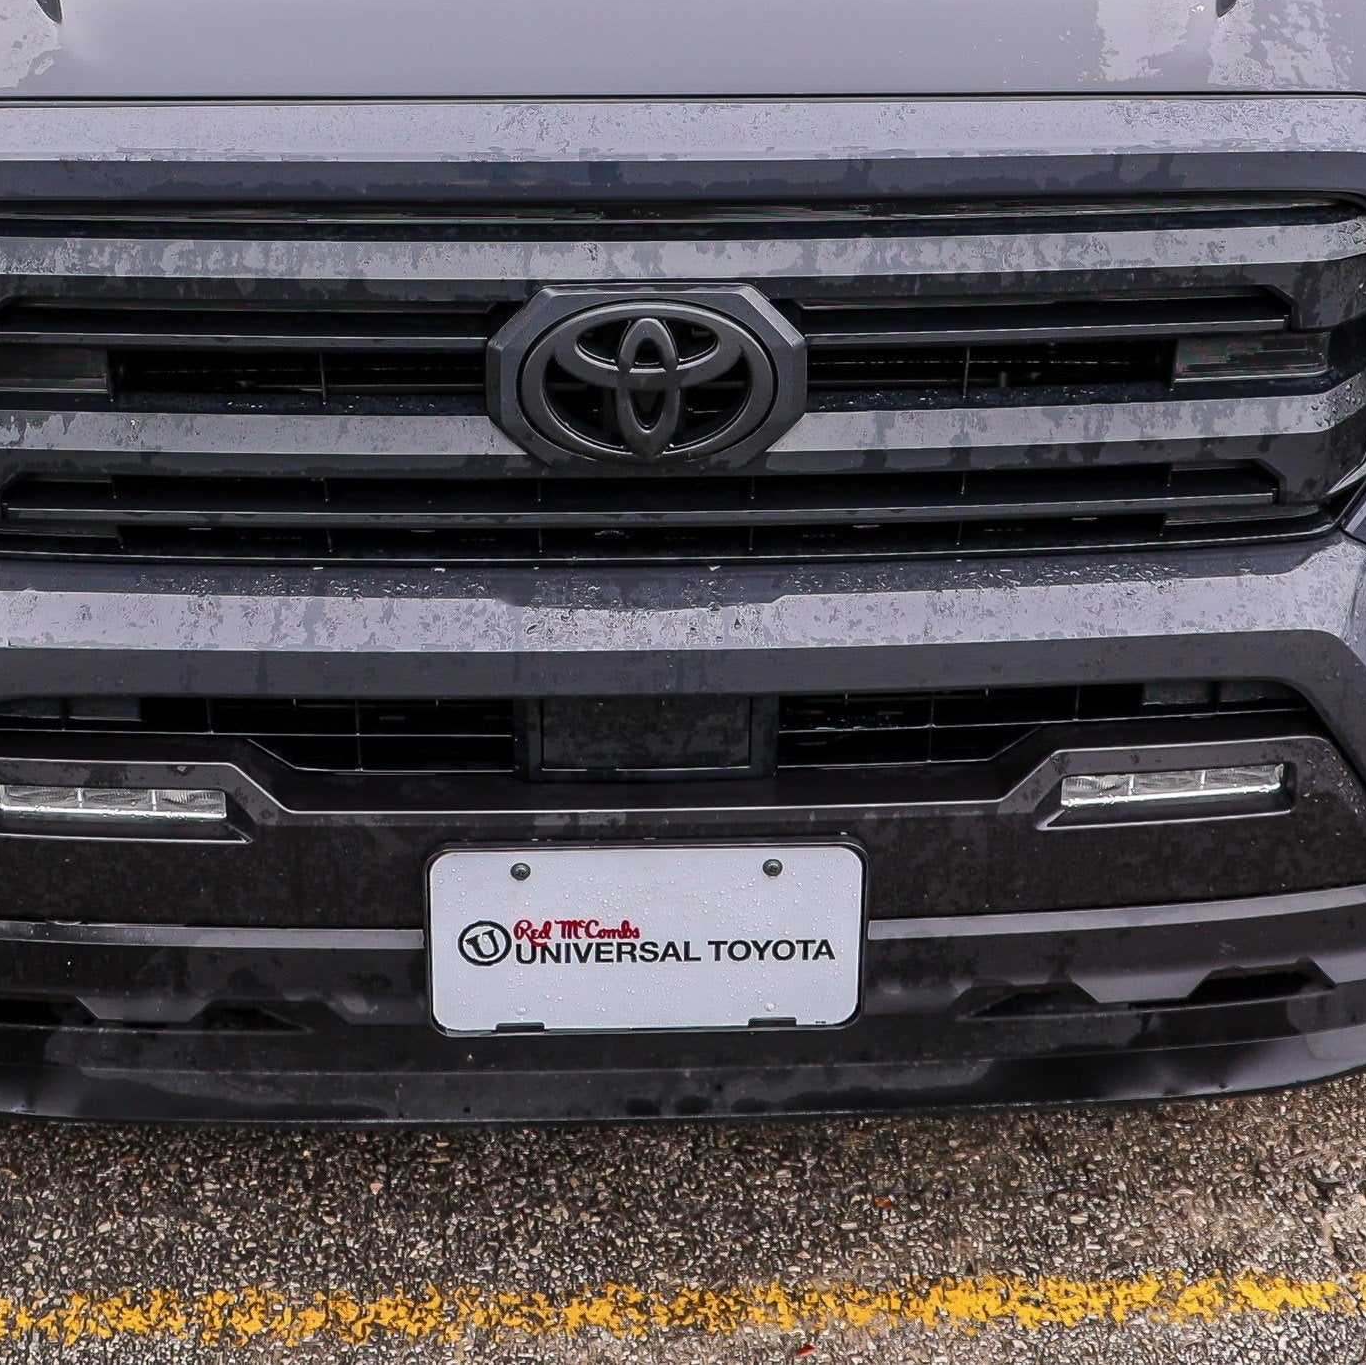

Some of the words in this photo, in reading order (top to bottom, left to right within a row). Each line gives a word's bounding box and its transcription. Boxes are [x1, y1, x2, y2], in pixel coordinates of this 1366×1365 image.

[513, 919, 552, 947] Red
[515, 940, 701, 965] UNIVERSAL
[708, 939, 836, 962] TOYOTA
